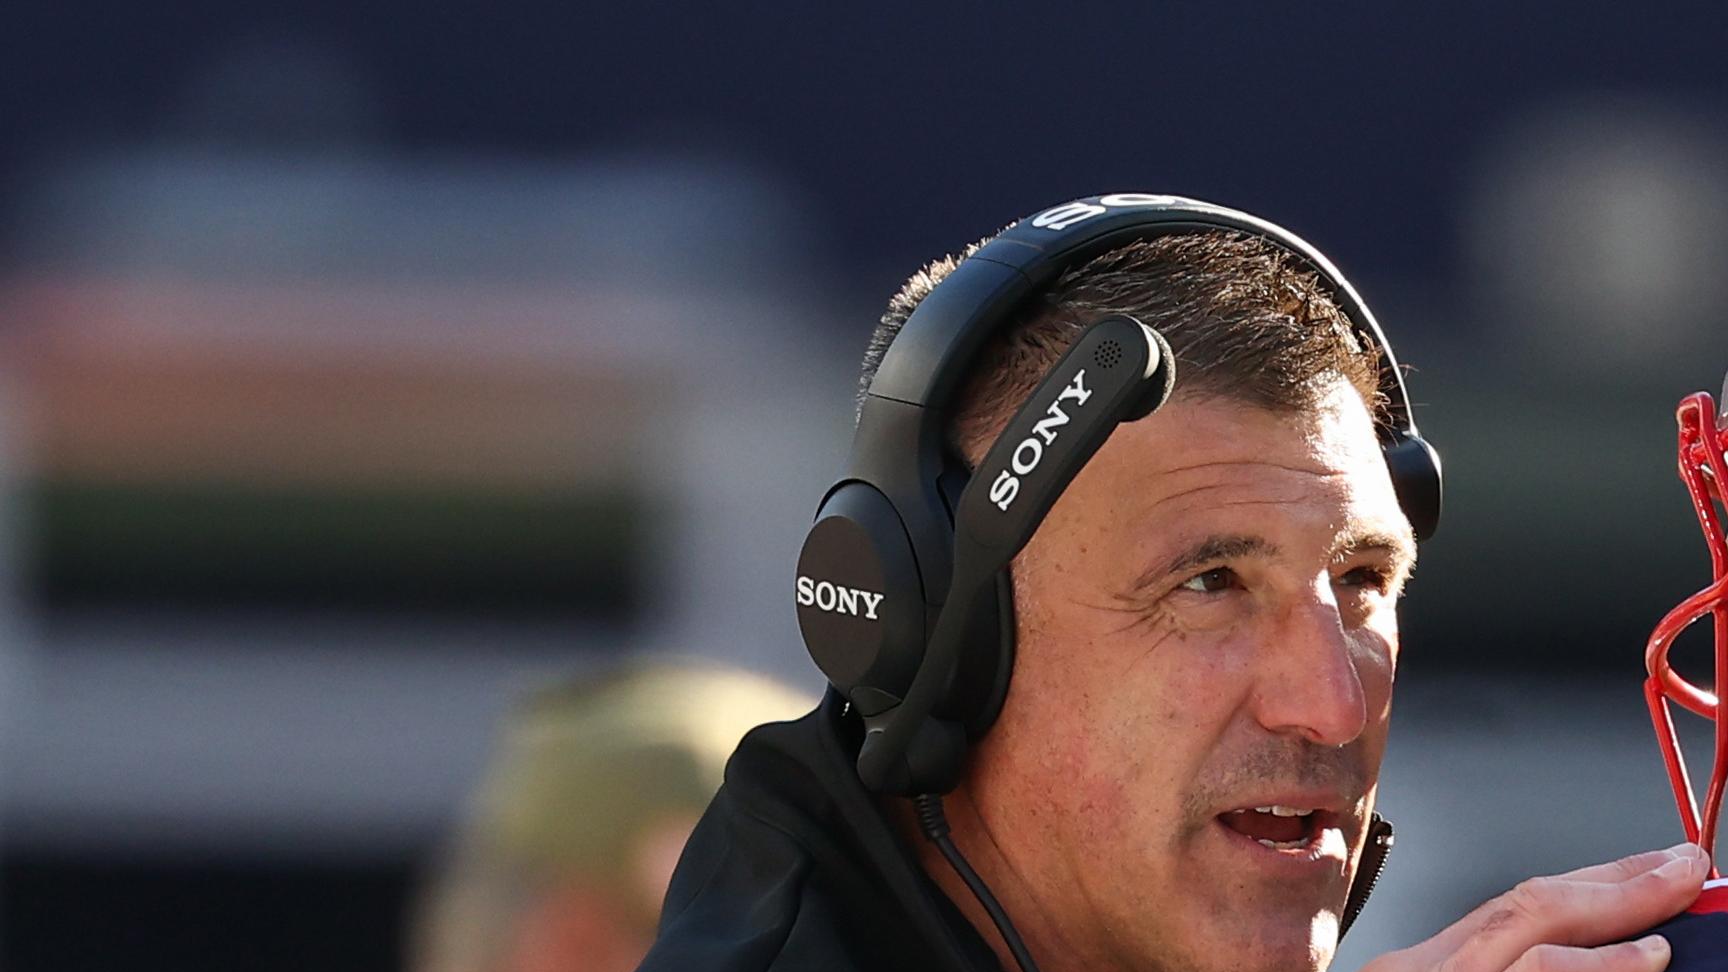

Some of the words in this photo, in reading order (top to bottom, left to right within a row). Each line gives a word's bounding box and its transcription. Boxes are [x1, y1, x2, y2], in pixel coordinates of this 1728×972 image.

[1031, 193, 1176, 231] SO
[988, 368, 1093, 512] SONY
[797, 575, 885, 620] SONY
